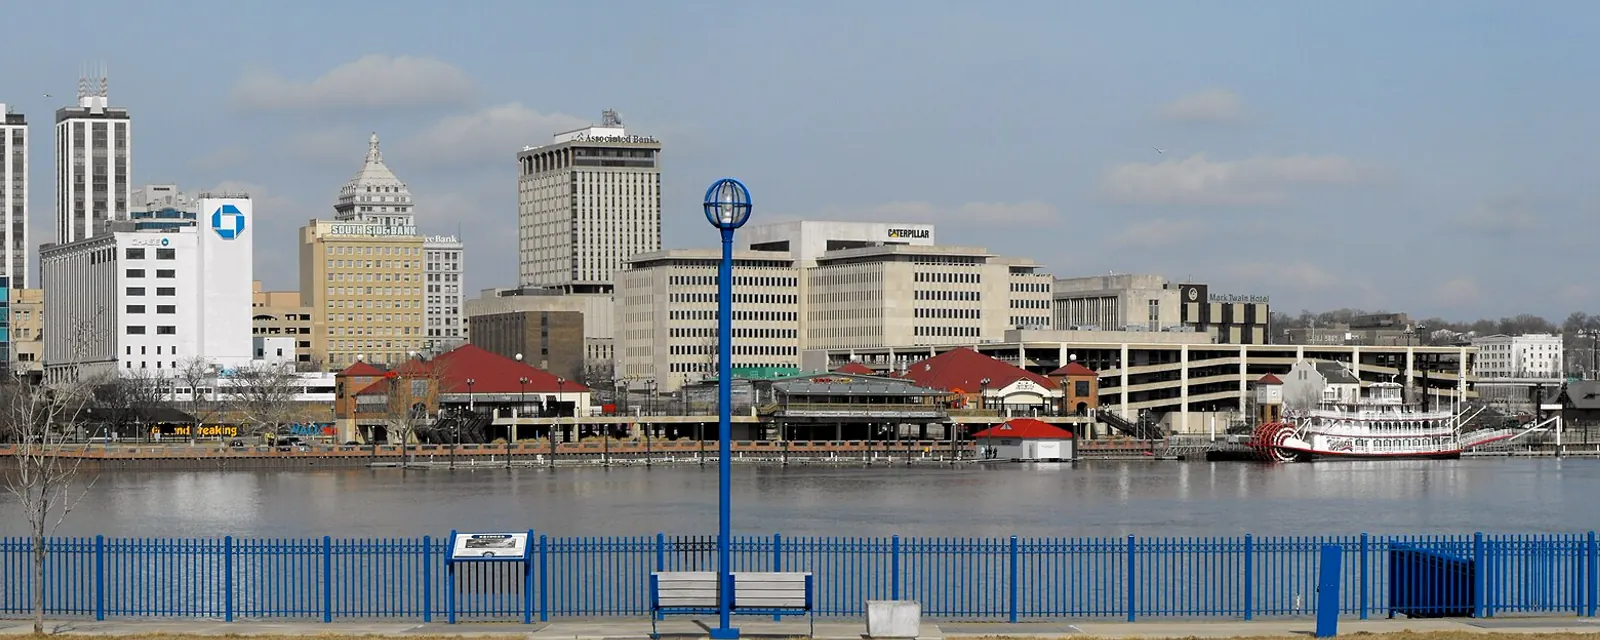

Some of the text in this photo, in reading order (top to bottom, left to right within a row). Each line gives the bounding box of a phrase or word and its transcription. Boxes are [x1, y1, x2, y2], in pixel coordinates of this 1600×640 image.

[586, 134, 656, 144] Associated Bank
[331, 225, 417, 236] SOUTH SIDE BANK
[888, 229, 930, 238] CATERPILLAR
[435, 234, 457, 243] Bank
[1209, 293, 1270, 303] Mark Twain Hotel
